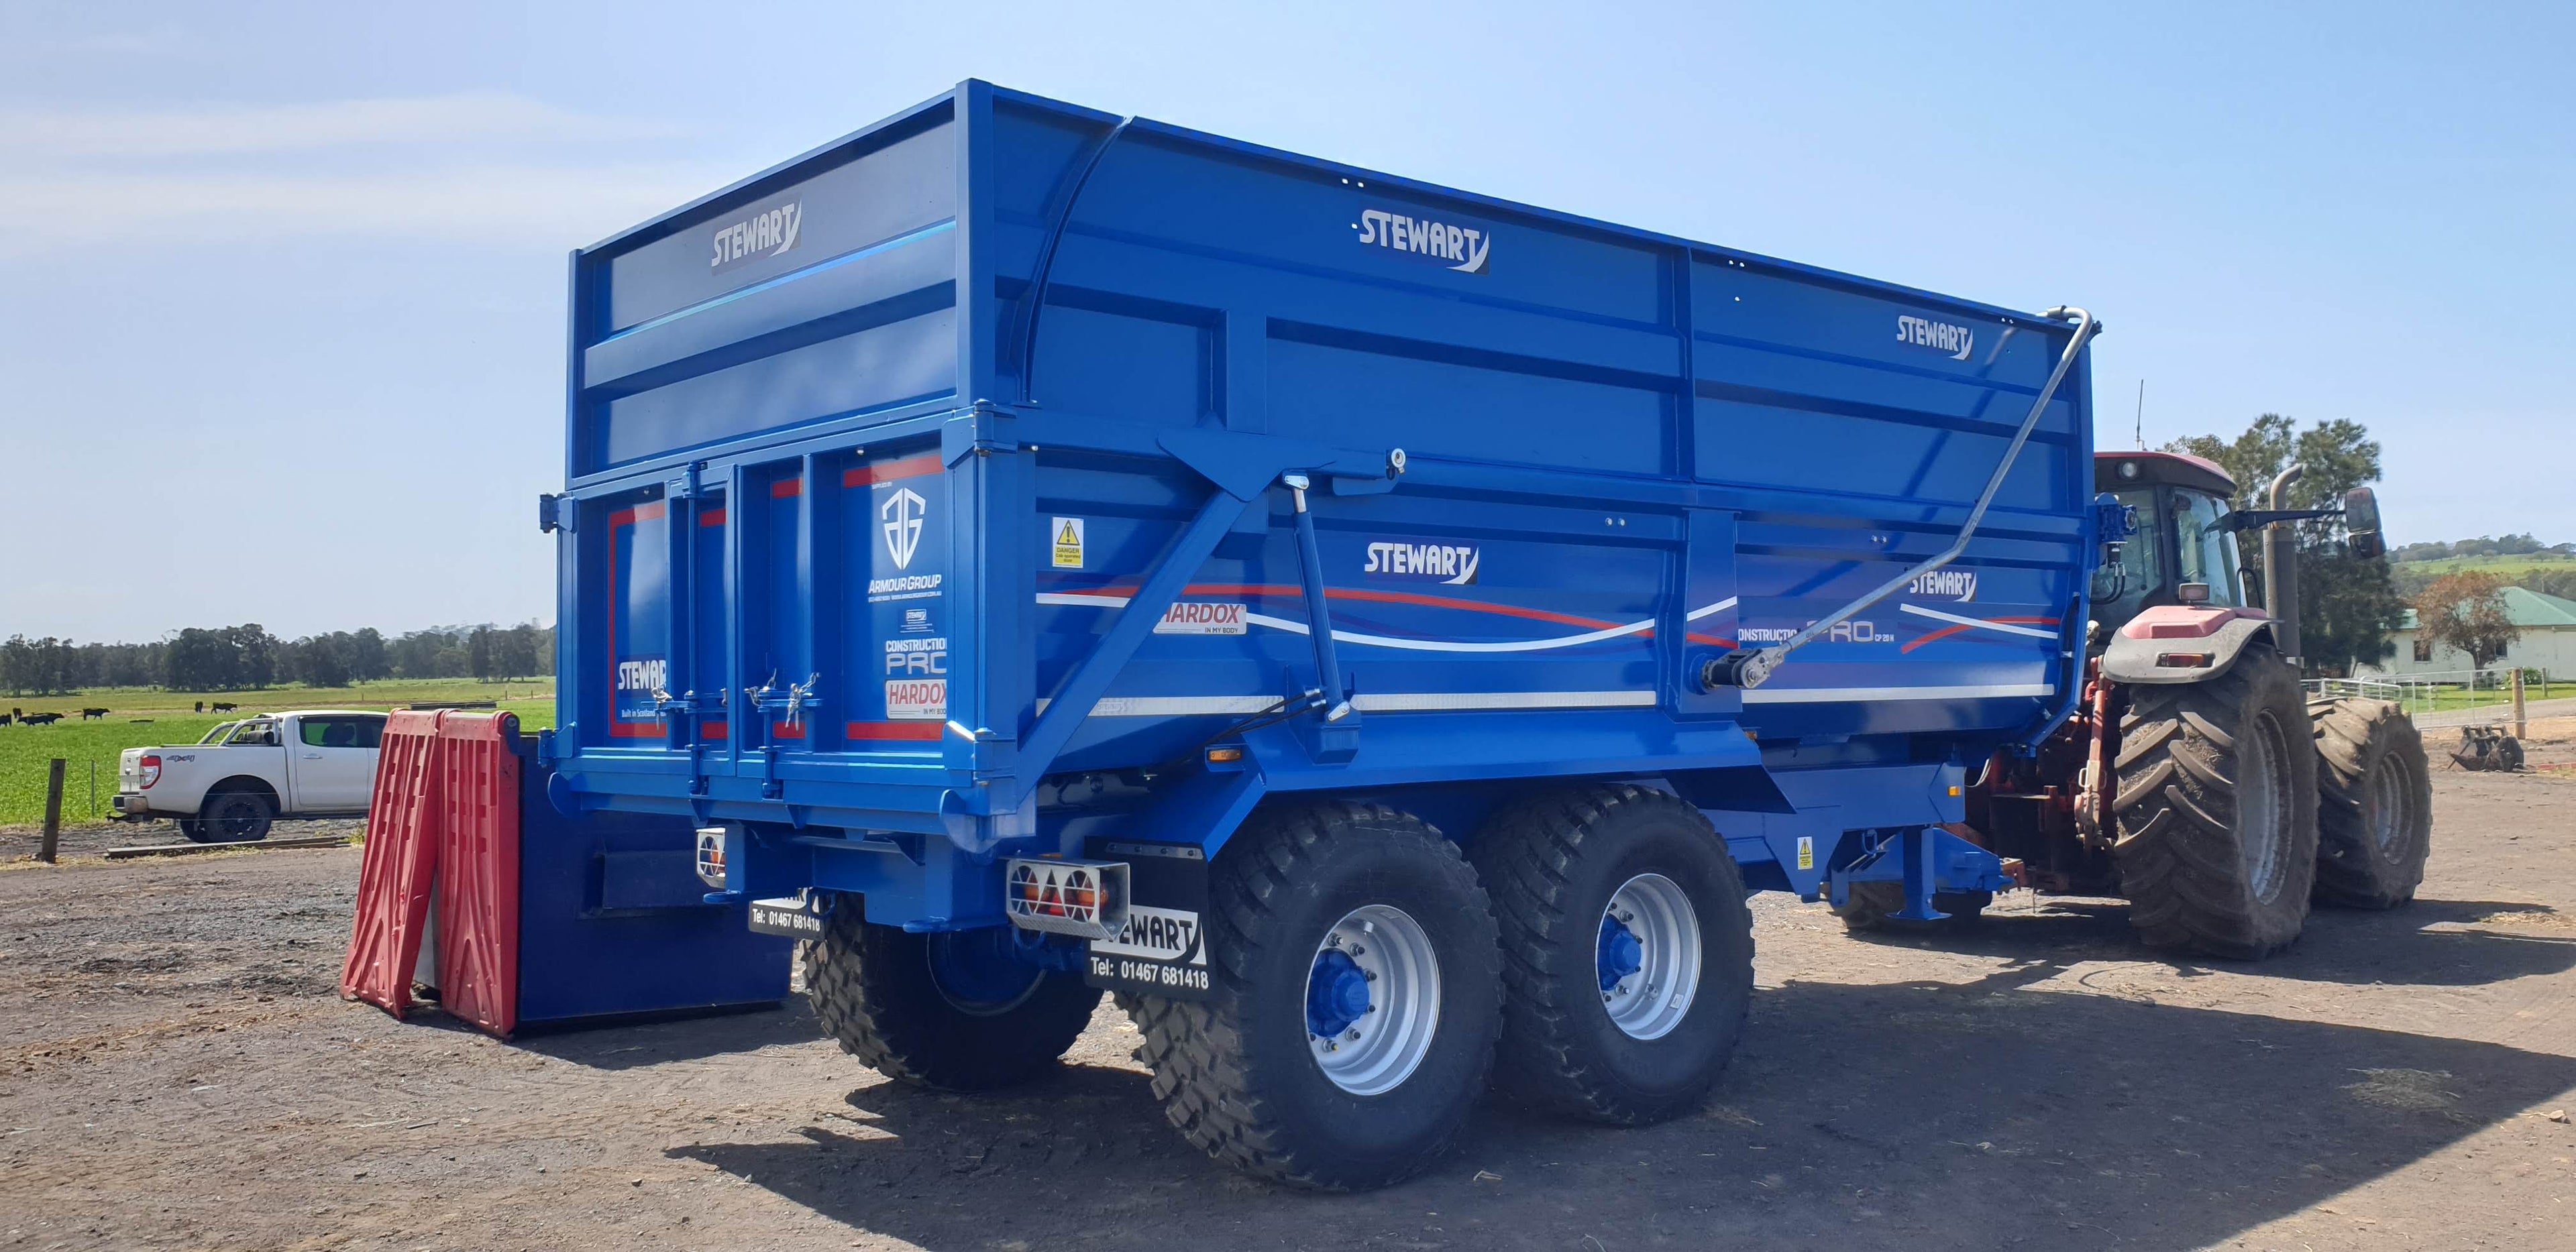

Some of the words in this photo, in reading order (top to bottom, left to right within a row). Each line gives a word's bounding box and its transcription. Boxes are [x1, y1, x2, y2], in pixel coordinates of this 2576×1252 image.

[711, 198, 802, 267] STEWART
[1359, 209, 1489, 273] STEWART
[1896, 315, 1973, 360] STEWART
[1364, 542, 1479, 585] STEWART
[1910, 571, 1976, 602] STEWART
[885, 637, 947, 652] CONSTRUCTIO
[618, 660, 667, 690] STEWAR
[637, 708, 656, 718] Scotland
[752, 908, 765, 924] Tel:
[769, 911, 792, 927] 01467
[793, 914, 820, 932] 681418
[1090, 956, 1114, 976] Tel:
[1121, 960, 1159, 982] 01467
[1162, 966, 1209, 990] 681418
